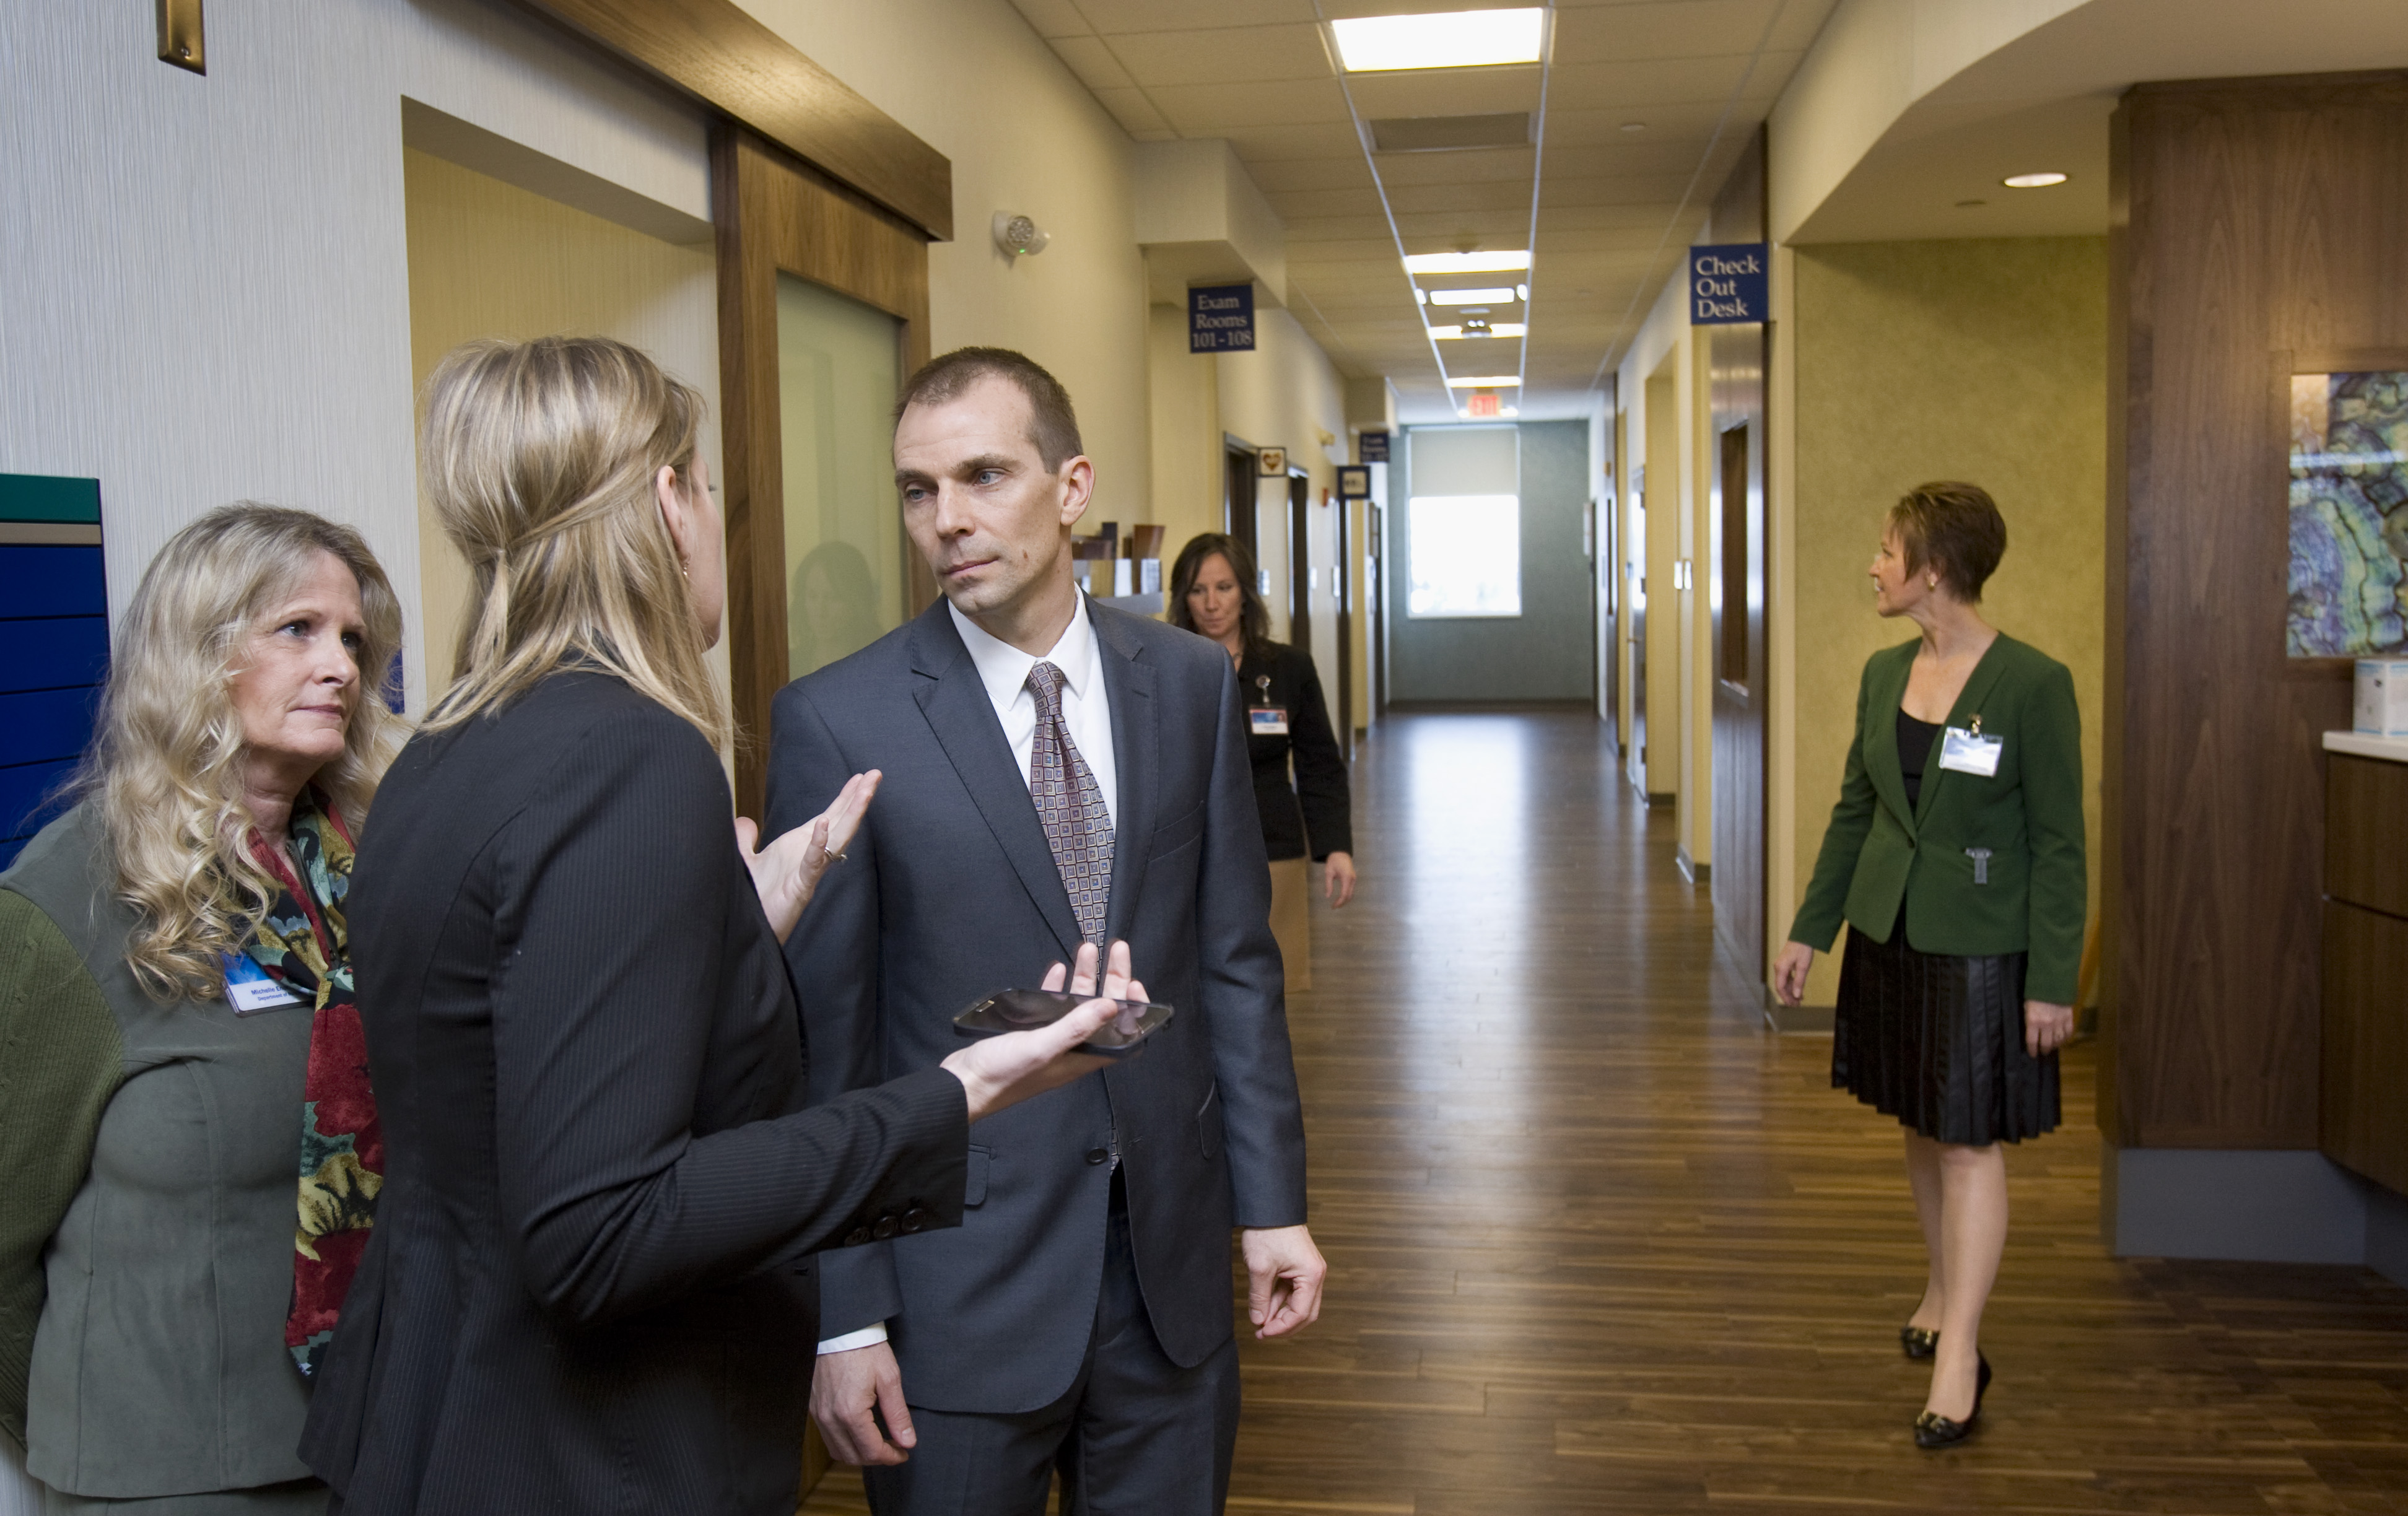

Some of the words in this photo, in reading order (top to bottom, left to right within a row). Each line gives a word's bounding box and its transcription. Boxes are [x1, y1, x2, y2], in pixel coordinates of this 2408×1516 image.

[1696, 254, 1760, 276] Check
[1696, 278, 1737, 297] Out
[1197, 294, 1239, 310] Exam
[1697, 297, 1748, 318] Desk
[1195, 313, 1247, 329] Rooms
[251, 987, 275, 995] Michelle
